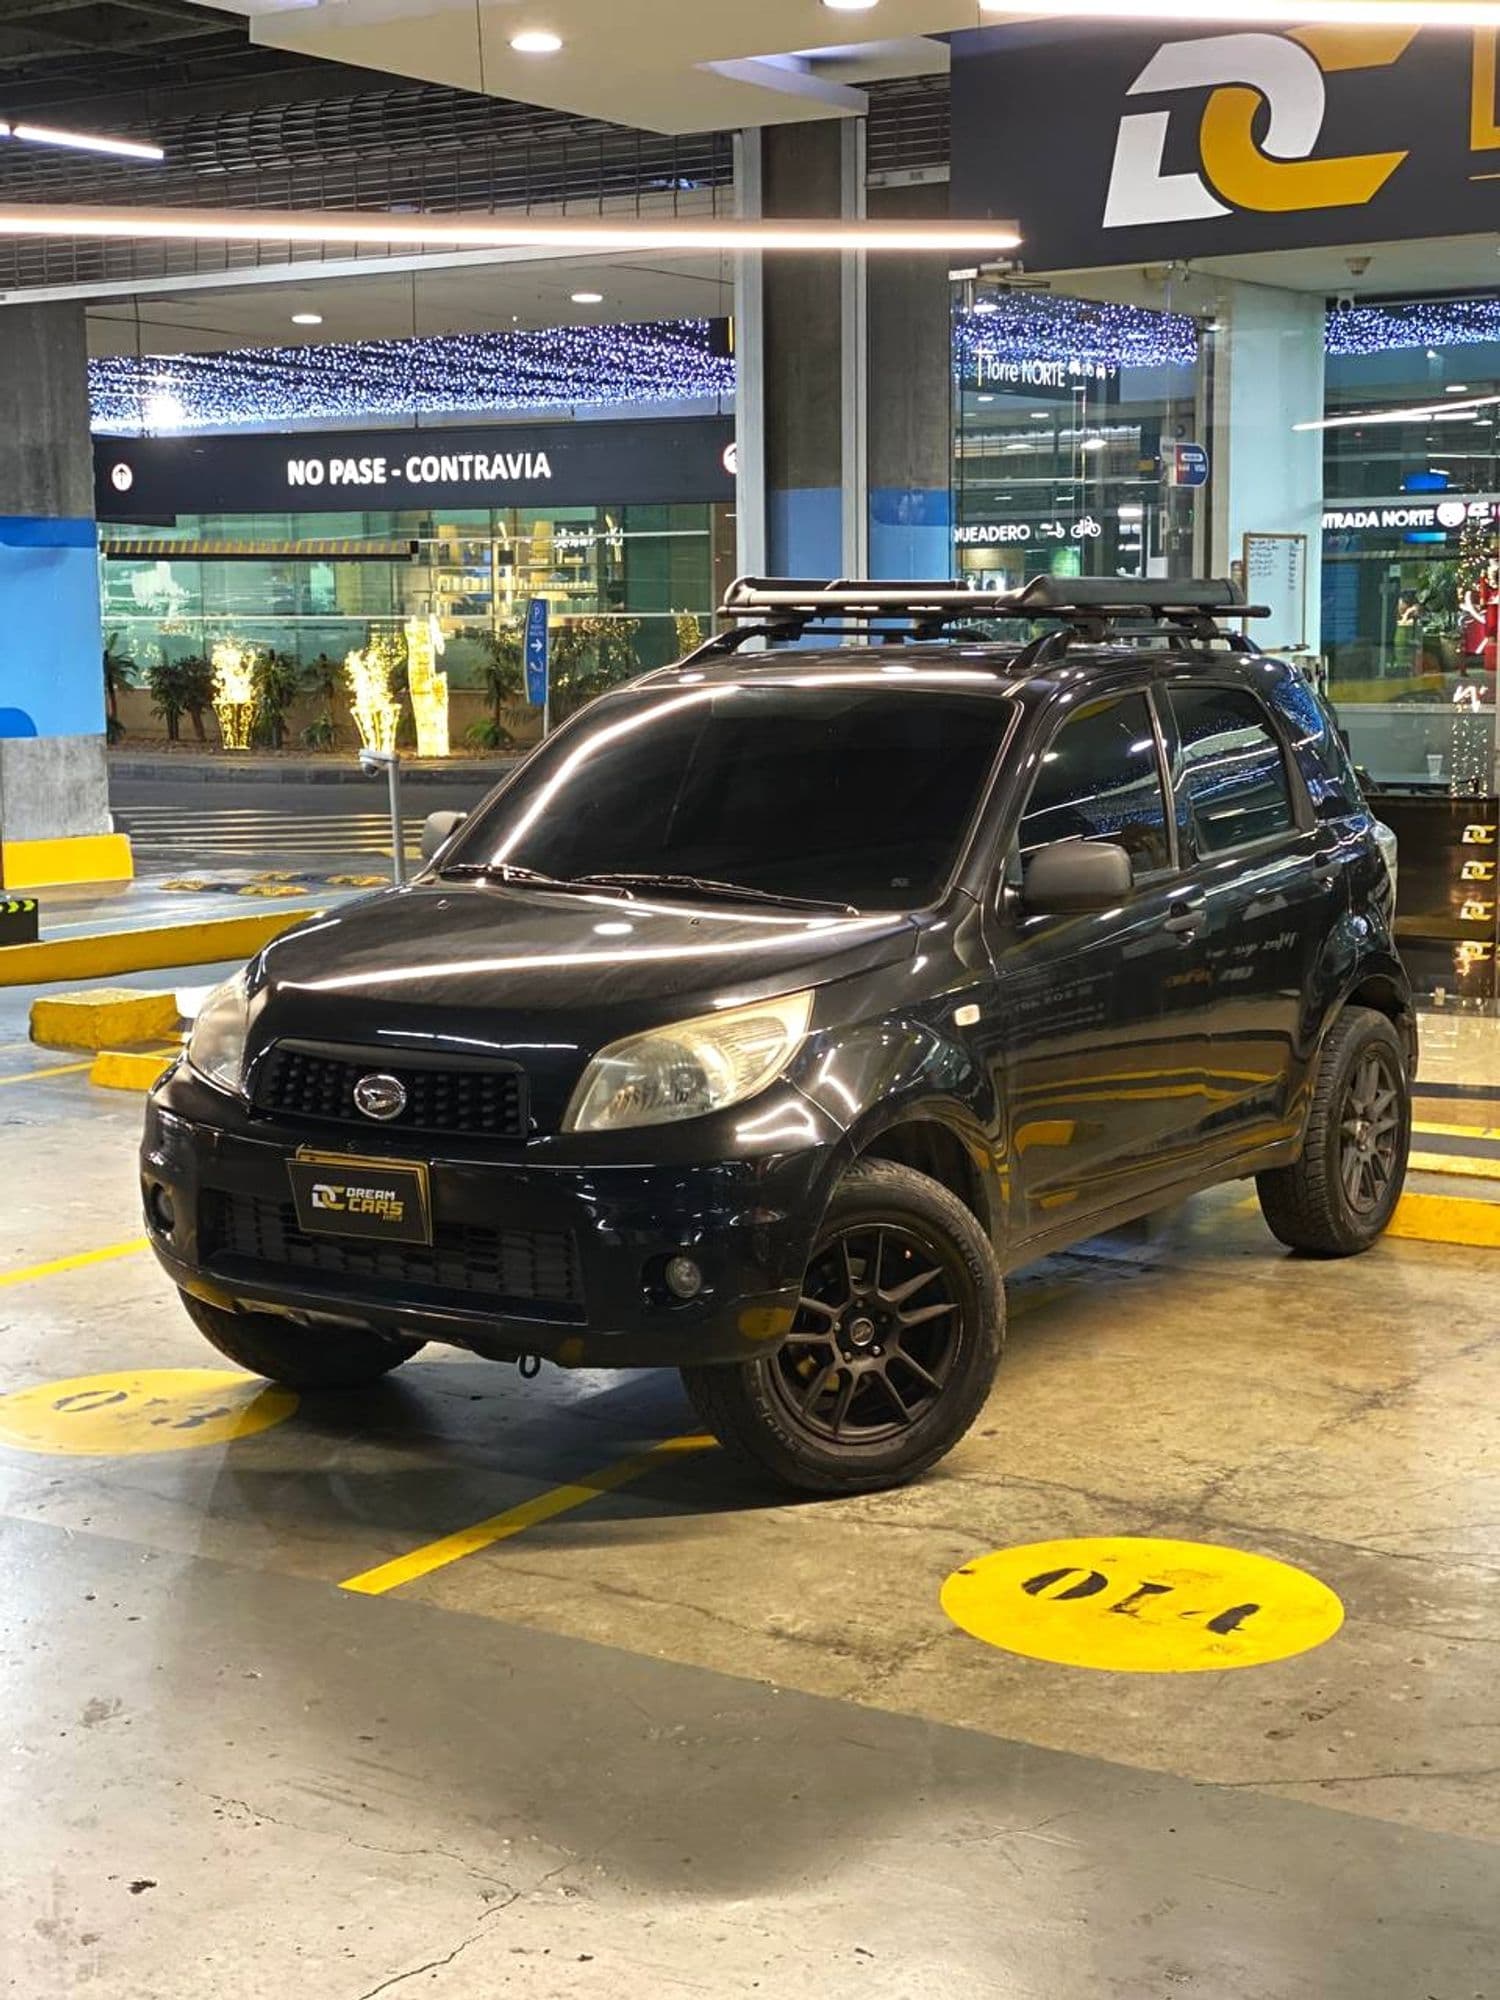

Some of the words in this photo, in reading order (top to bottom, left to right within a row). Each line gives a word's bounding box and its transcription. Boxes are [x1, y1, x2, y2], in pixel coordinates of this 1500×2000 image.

[986, 355, 1019, 382] Torre
[1021, 358, 1066, 388] NORTE
[287, 459, 324, 486] NO
[329, 457, 387, 485] PASE
[405, 452, 551, 483] CONTRAVIA
[1382, 509, 1434, 527] NORTE
[346, 1187, 396, 1201] DREAM
[348, 1198, 404, 1216] CARS
